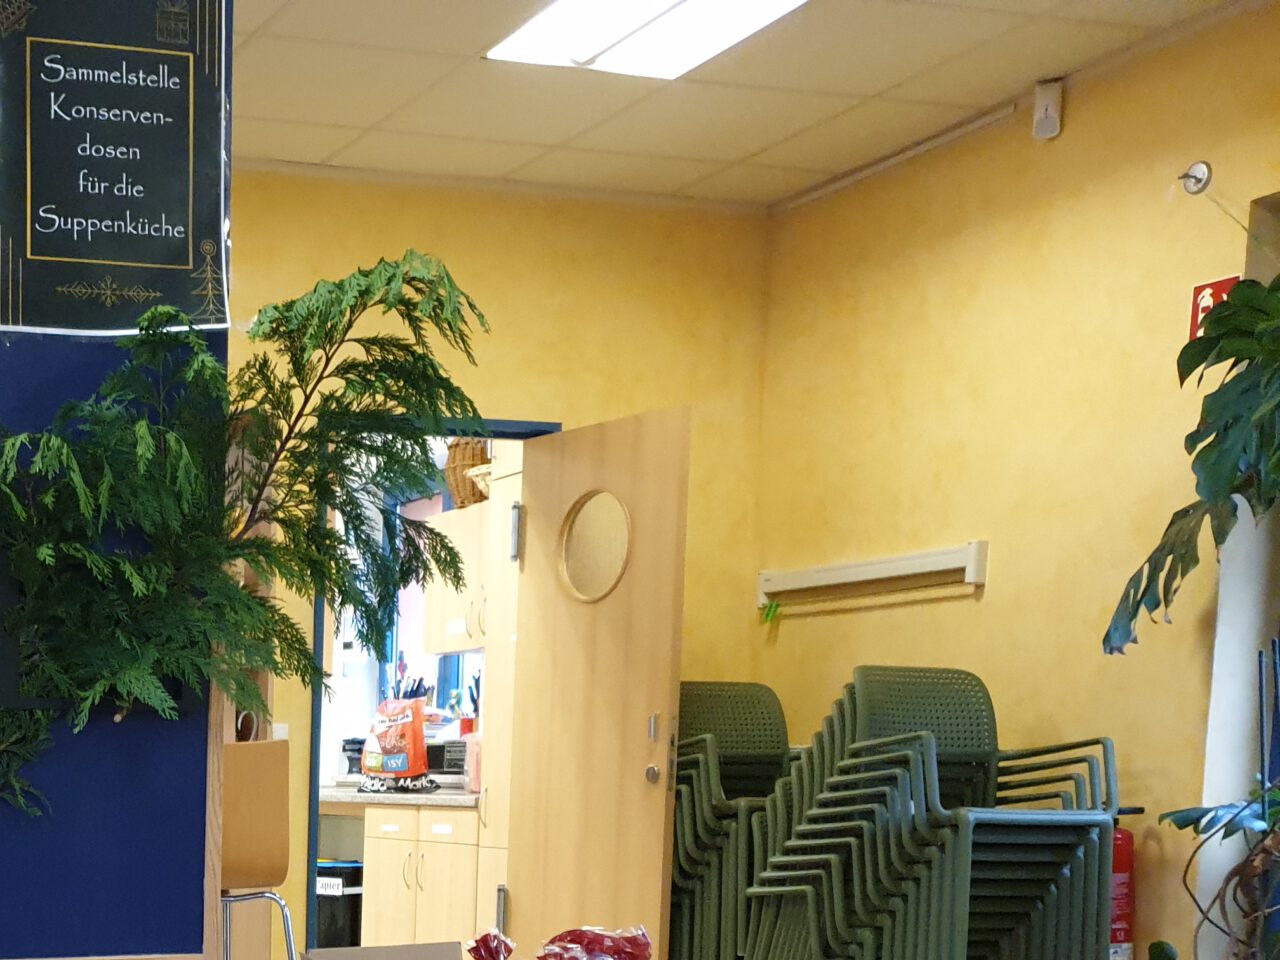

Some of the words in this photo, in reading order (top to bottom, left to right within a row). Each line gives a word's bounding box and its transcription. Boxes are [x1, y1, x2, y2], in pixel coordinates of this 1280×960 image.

[40, 54, 181, 90] Sammelstelle
[50, 92, 174, 126] Konserven-
[77, 133, 141, 160] dosen
[79, 169, 110, 196] für
[114, 173, 145, 198] die
[35, 204, 186, 241] Suppenküche
